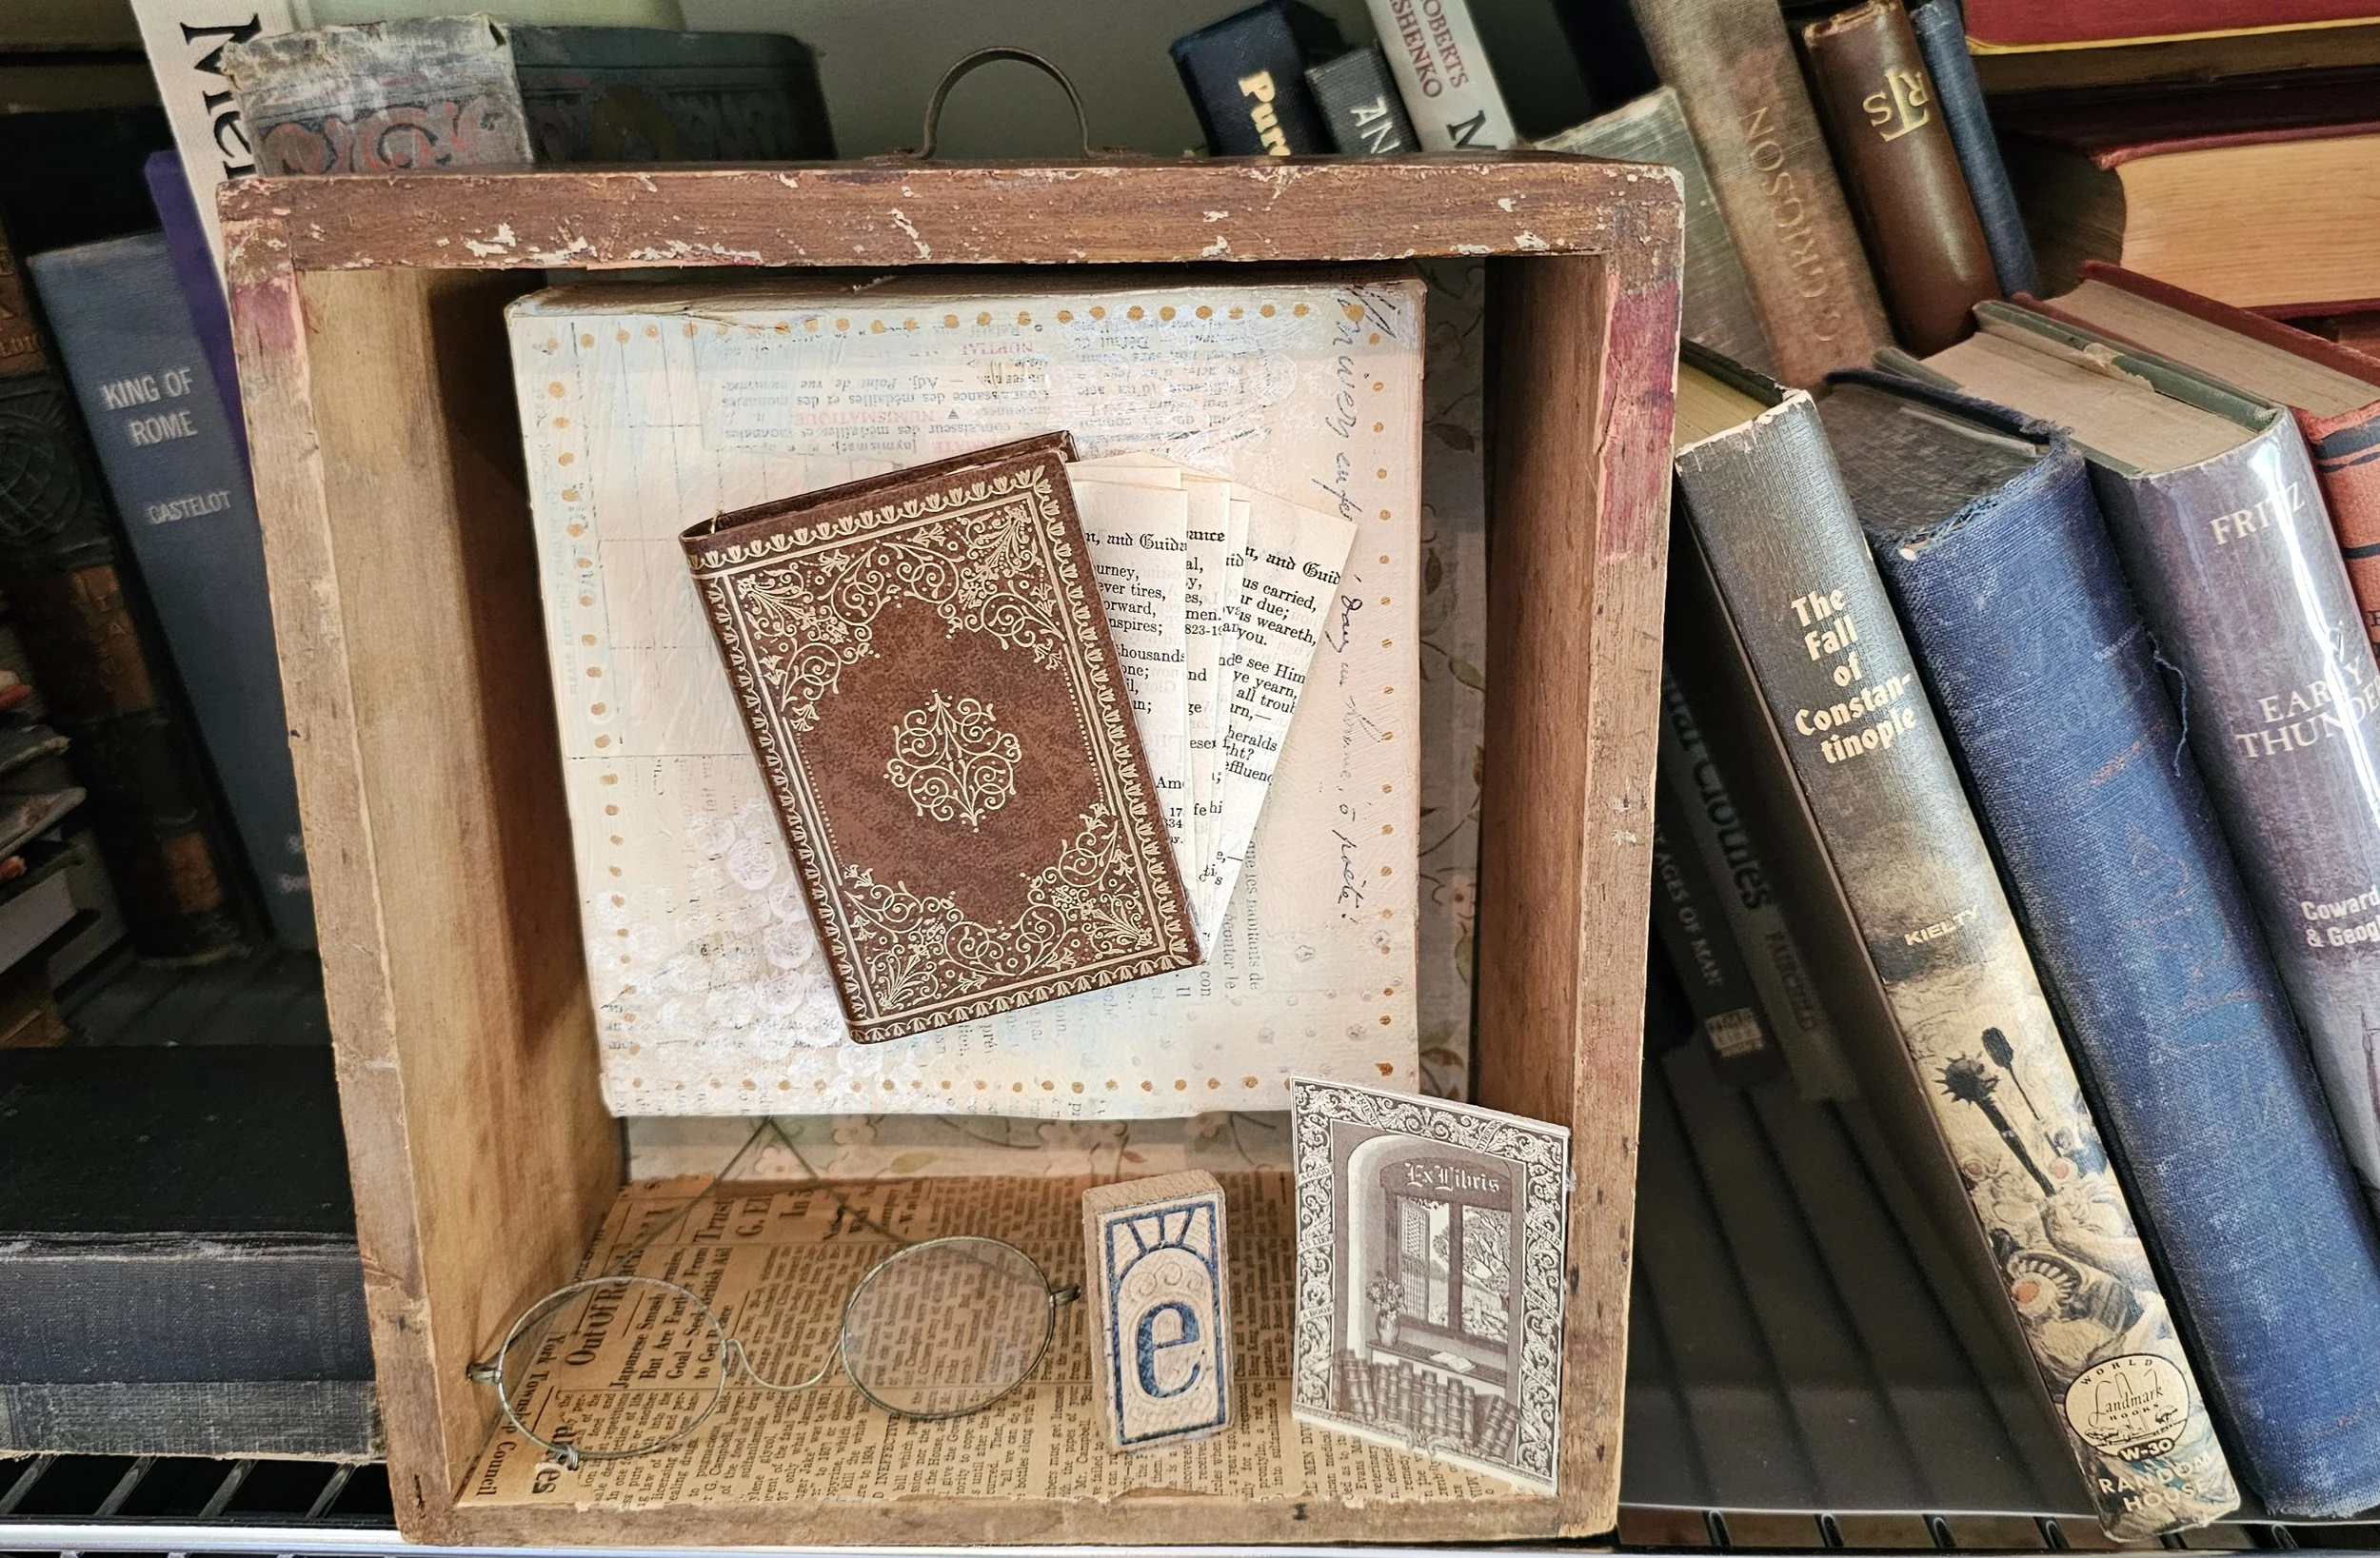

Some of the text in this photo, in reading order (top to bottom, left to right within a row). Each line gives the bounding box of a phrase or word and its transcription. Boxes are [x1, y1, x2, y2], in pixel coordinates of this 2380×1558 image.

[1420, 0, 1469, 89] OBERTS
[100, 366, 192, 410] KING OF
[129, 411, 198, 446] ROME
[146, 490, 231, 524] CASTELOT
[2209, 481, 2306, 547] FRIZ
[1107, 532, 1134, 546] and
[1187, 530, 1225, 542] ance
[1094, 563, 1140, 582] urney,
[1266, 552, 1297, 571] and
[1131, 582, 1166, 601] tires,
[1257, 596, 1290, 621] due;
[1262, 583, 1317, 614] carried,
[1791, 588, 1846, 627] The
[1238, 626, 1268, 646] you.
[1257, 614, 1317, 647] weareth,
[1804, 614, 1858, 661] Fall
[1246, 656, 1306, 685] see Him
[1834, 651, 1862, 687] of
[1236, 688, 1256, 702] all
[1253, 677, 1298, 700] yearn,
[1795, 673, 1911, 736] Constan-
[2257, 655, 2363, 724] EARY
[2234, 674, 2380, 759] THUNDE
[1228, 725, 1278, 752] heralds
[1820, 707, 1917, 764] tinople
[1903, 904, 1979, 946] KIELTY
[2306, 928, 2325, 948] &
[1404, 1162, 1499, 1193] Ex Libris
[537, 1334, 566, 1365] York
[564, 1331, 607, 1366] Out
[608, 1292, 667, 1388] Japanese Smash
[638, 1357, 664, 1380] But
[652, 1329, 674, 1350] Are
[699, 1342, 720, 1362] Get
[1136, 1298, 1202, 1400] e
[665, 1351, 691, 1380] Goal
[694, 1367, 710, 1379] to
[2080, 1358, 2153, 1386] WORLD
[2088, 1369, 2164, 1428] Landmark
[758, 1390, 789, 1464] glycol, another
[783, 1390, 818, 1484] only what Jamaica
[1063, 1428, 1078, 1453] pipes
[709, 1428, 737, 1476] Campbell,
[729, 1437, 745, 1458] food
[875, 1411, 902, 1486] INEFFECTIVE
[971, 1434, 989, 1485] until after
[1015, 1428, 1035, 1489] bottles along
[1049, 1443, 1061, 1466] must
[1319, 1430, 1333, 1467] medical
[1381, 1447, 1398, 1483] decided
[2119, 1439, 2173, 1462] W-30
[477, 1441, 518, 1495] Council
[651, 1457, 680, 1501] licensing
[840, 1471, 855, 1489] kill
[893, 1440, 915, 1491] bill which
[1270, 1466, 1283, 1486] into
[1354, 1460, 1368, 1490] Evans
[1367, 1443, 1383, 1495] veterinary
[1398, 1453, 1414, 1491] remedy
[2098, 1451, 2211, 1494] RANDOM
[2123, 1479, 2207, 1512] HOUSE
